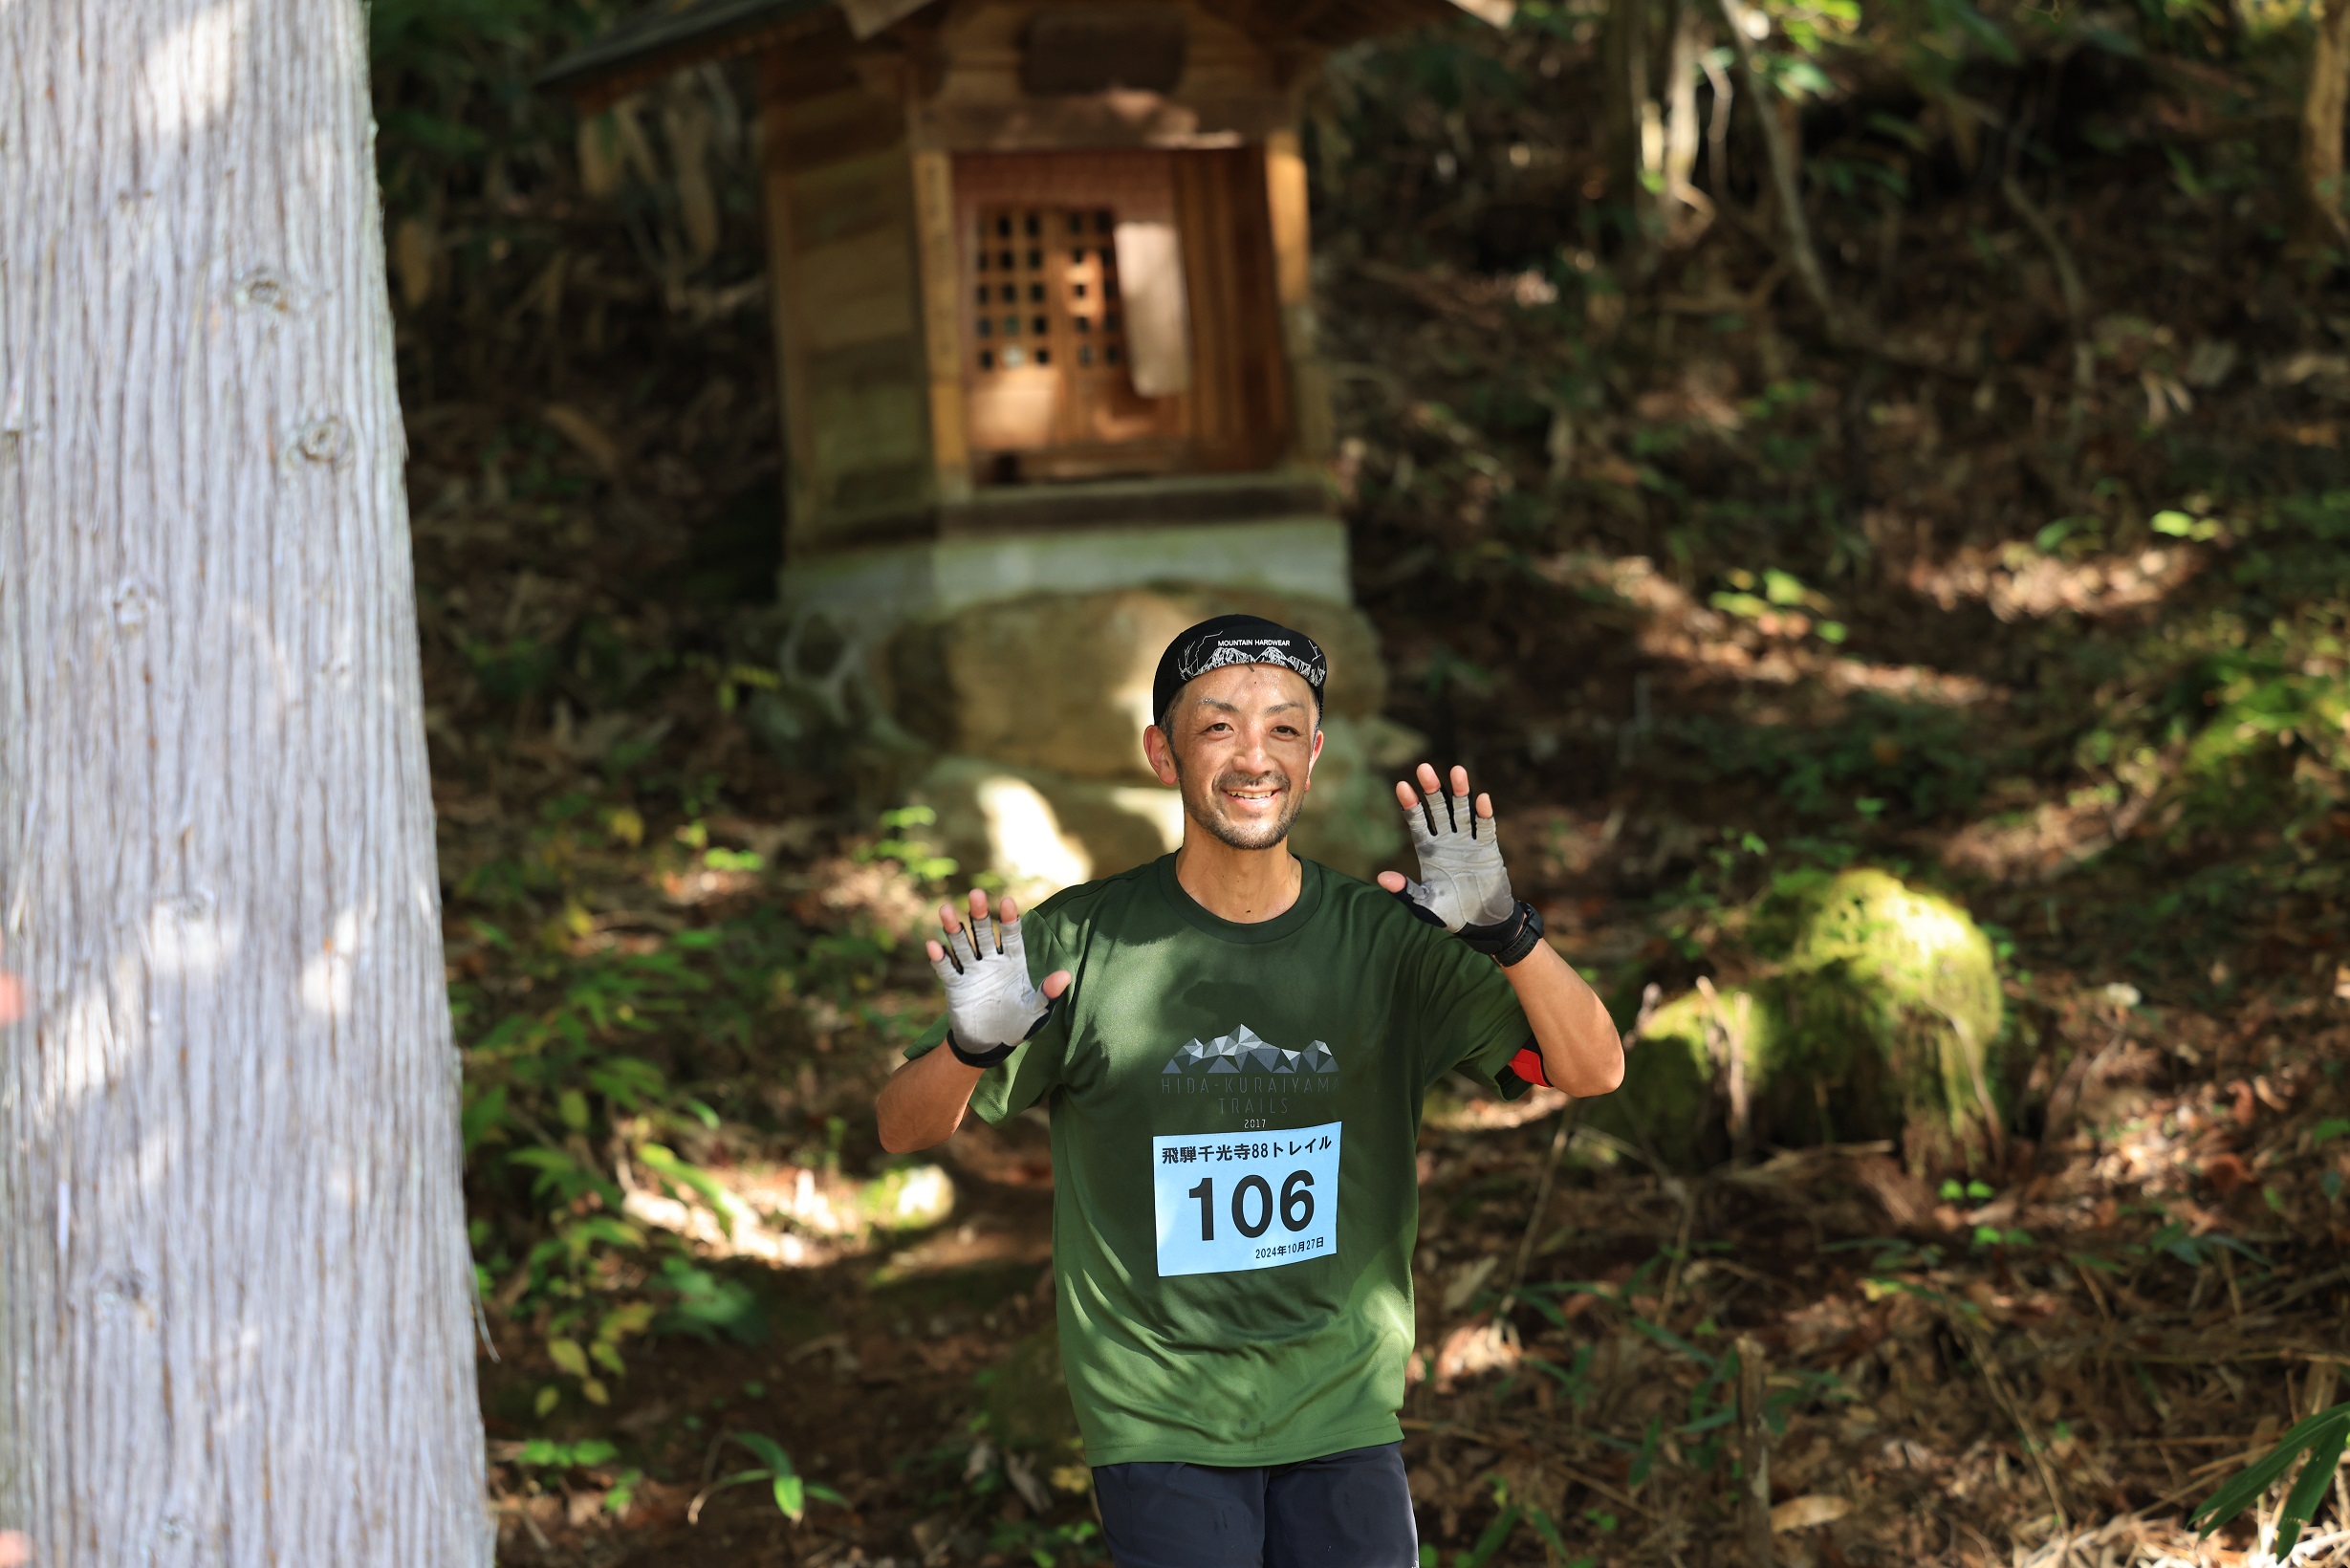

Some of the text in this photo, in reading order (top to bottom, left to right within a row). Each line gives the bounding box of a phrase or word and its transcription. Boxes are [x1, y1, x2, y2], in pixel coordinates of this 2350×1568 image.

[1219, 1099, 1288, 1114] TRAILS
[1244, 1119, 1267, 1129] 2017
[1162, 1135, 1333, 1165] 飛騨千光寺88トレイル
[1188, 1169, 1315, 1241] 106
[1255, 1236, 1325, 1259] 2024年10月27日
